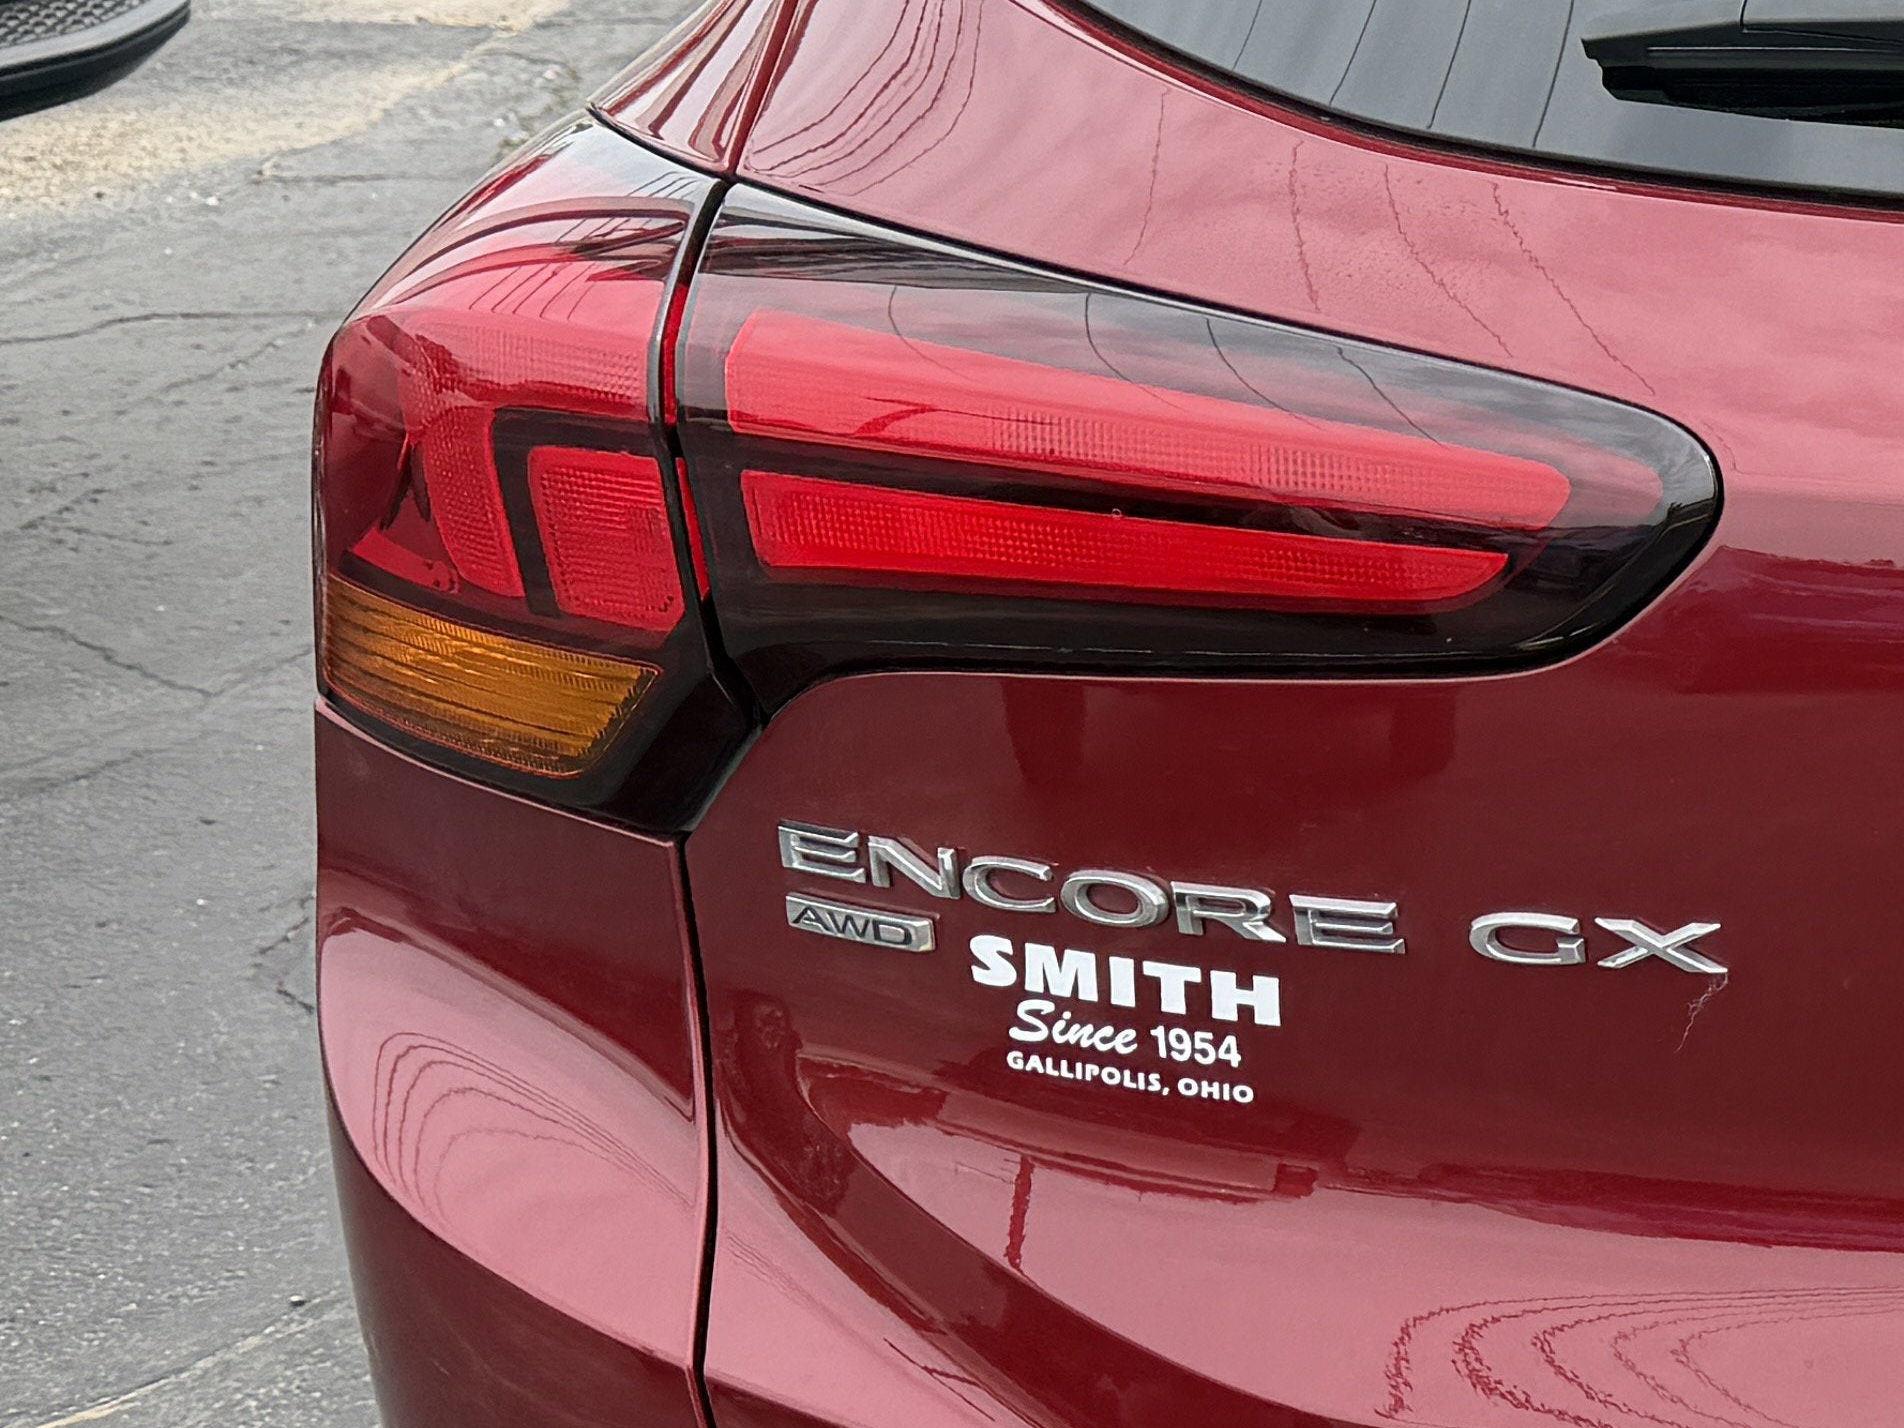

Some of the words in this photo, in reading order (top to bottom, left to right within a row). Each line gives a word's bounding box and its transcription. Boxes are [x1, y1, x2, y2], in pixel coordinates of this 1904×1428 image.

[777, 819, 1405, 954] ENCORE
[1469, 911, 1729, 974] GX
[791, 906, 914, 946] AWD
[969, 934, 1281, 1027] SMITH
[1008, 998, 1138, 1055] Since
[1150, 1025, 1242, 1068] 1954
[1006, 1050, 1170, 1095] GALLIPOLIS,
[1176, 1077, 1255, 1104] OHIO
